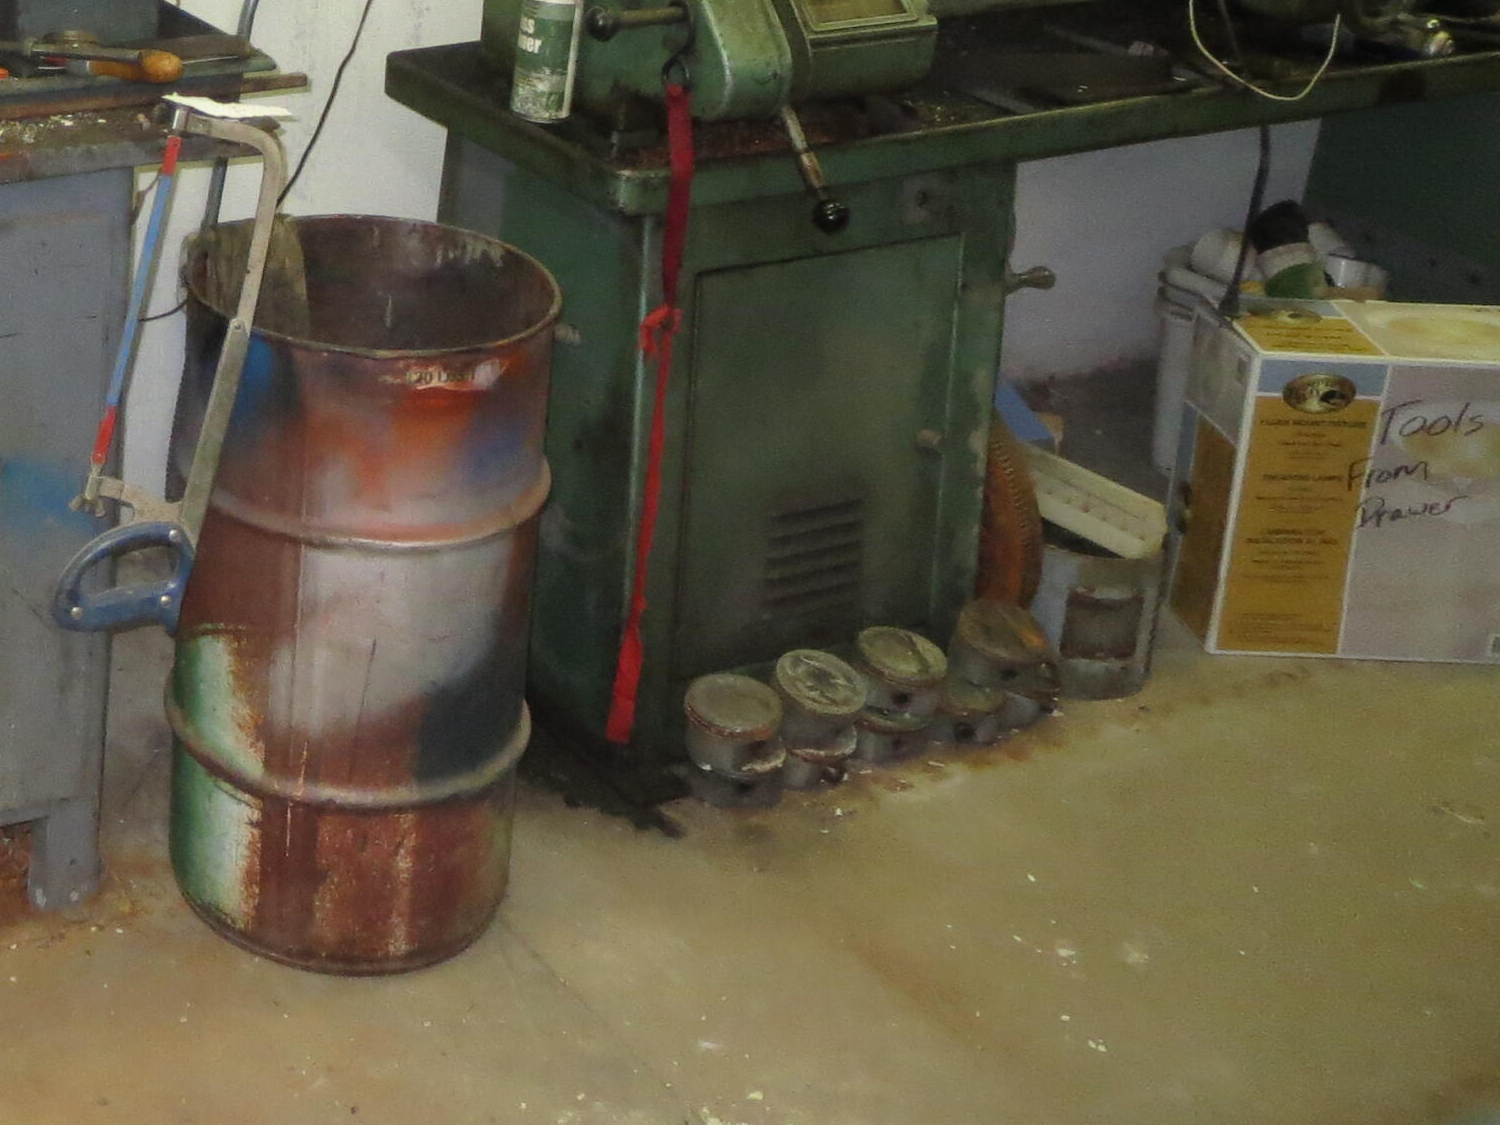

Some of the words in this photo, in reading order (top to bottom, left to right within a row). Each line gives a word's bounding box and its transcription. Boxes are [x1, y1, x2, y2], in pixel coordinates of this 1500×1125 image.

[1380, 399, 1485, 445] Tools
[1348, 457, 1430, 492] From
[1357, 495, 1468, 528] Drawer
